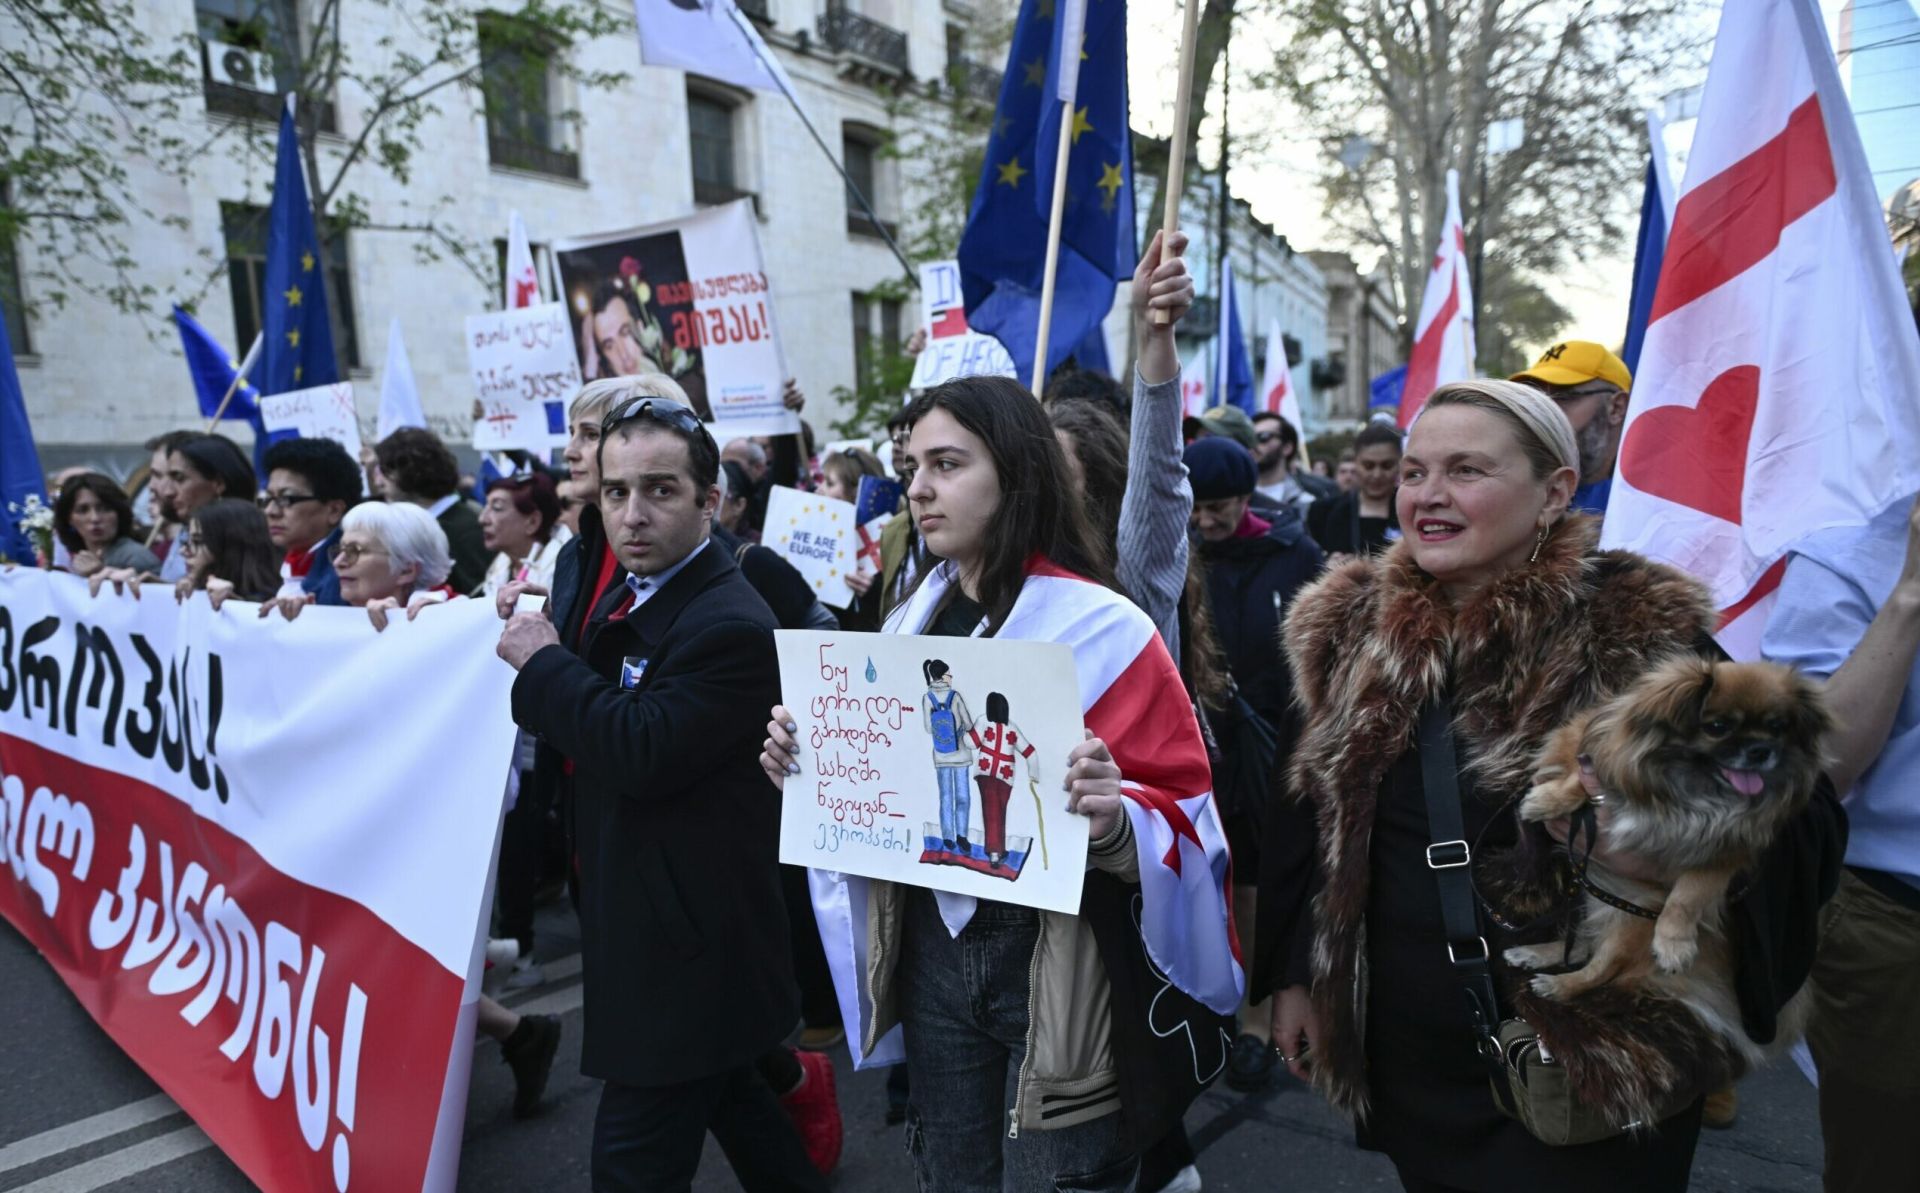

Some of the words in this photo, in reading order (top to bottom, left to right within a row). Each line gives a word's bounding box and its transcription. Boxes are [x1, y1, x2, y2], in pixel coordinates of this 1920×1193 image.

[671, 302, 770, 349] მიშას!
[790, 542, 833, 562] EUROPE
[793, 531, 811, 543] WE
[814, 536, 836, 550] ARE
[820, 643, 848, 692] ნუ
[815, 751, 881, 785] სახლში
[814, 822, 911, 853] ევროპაში!
[89, 823, 368, 1193] კანონს!
